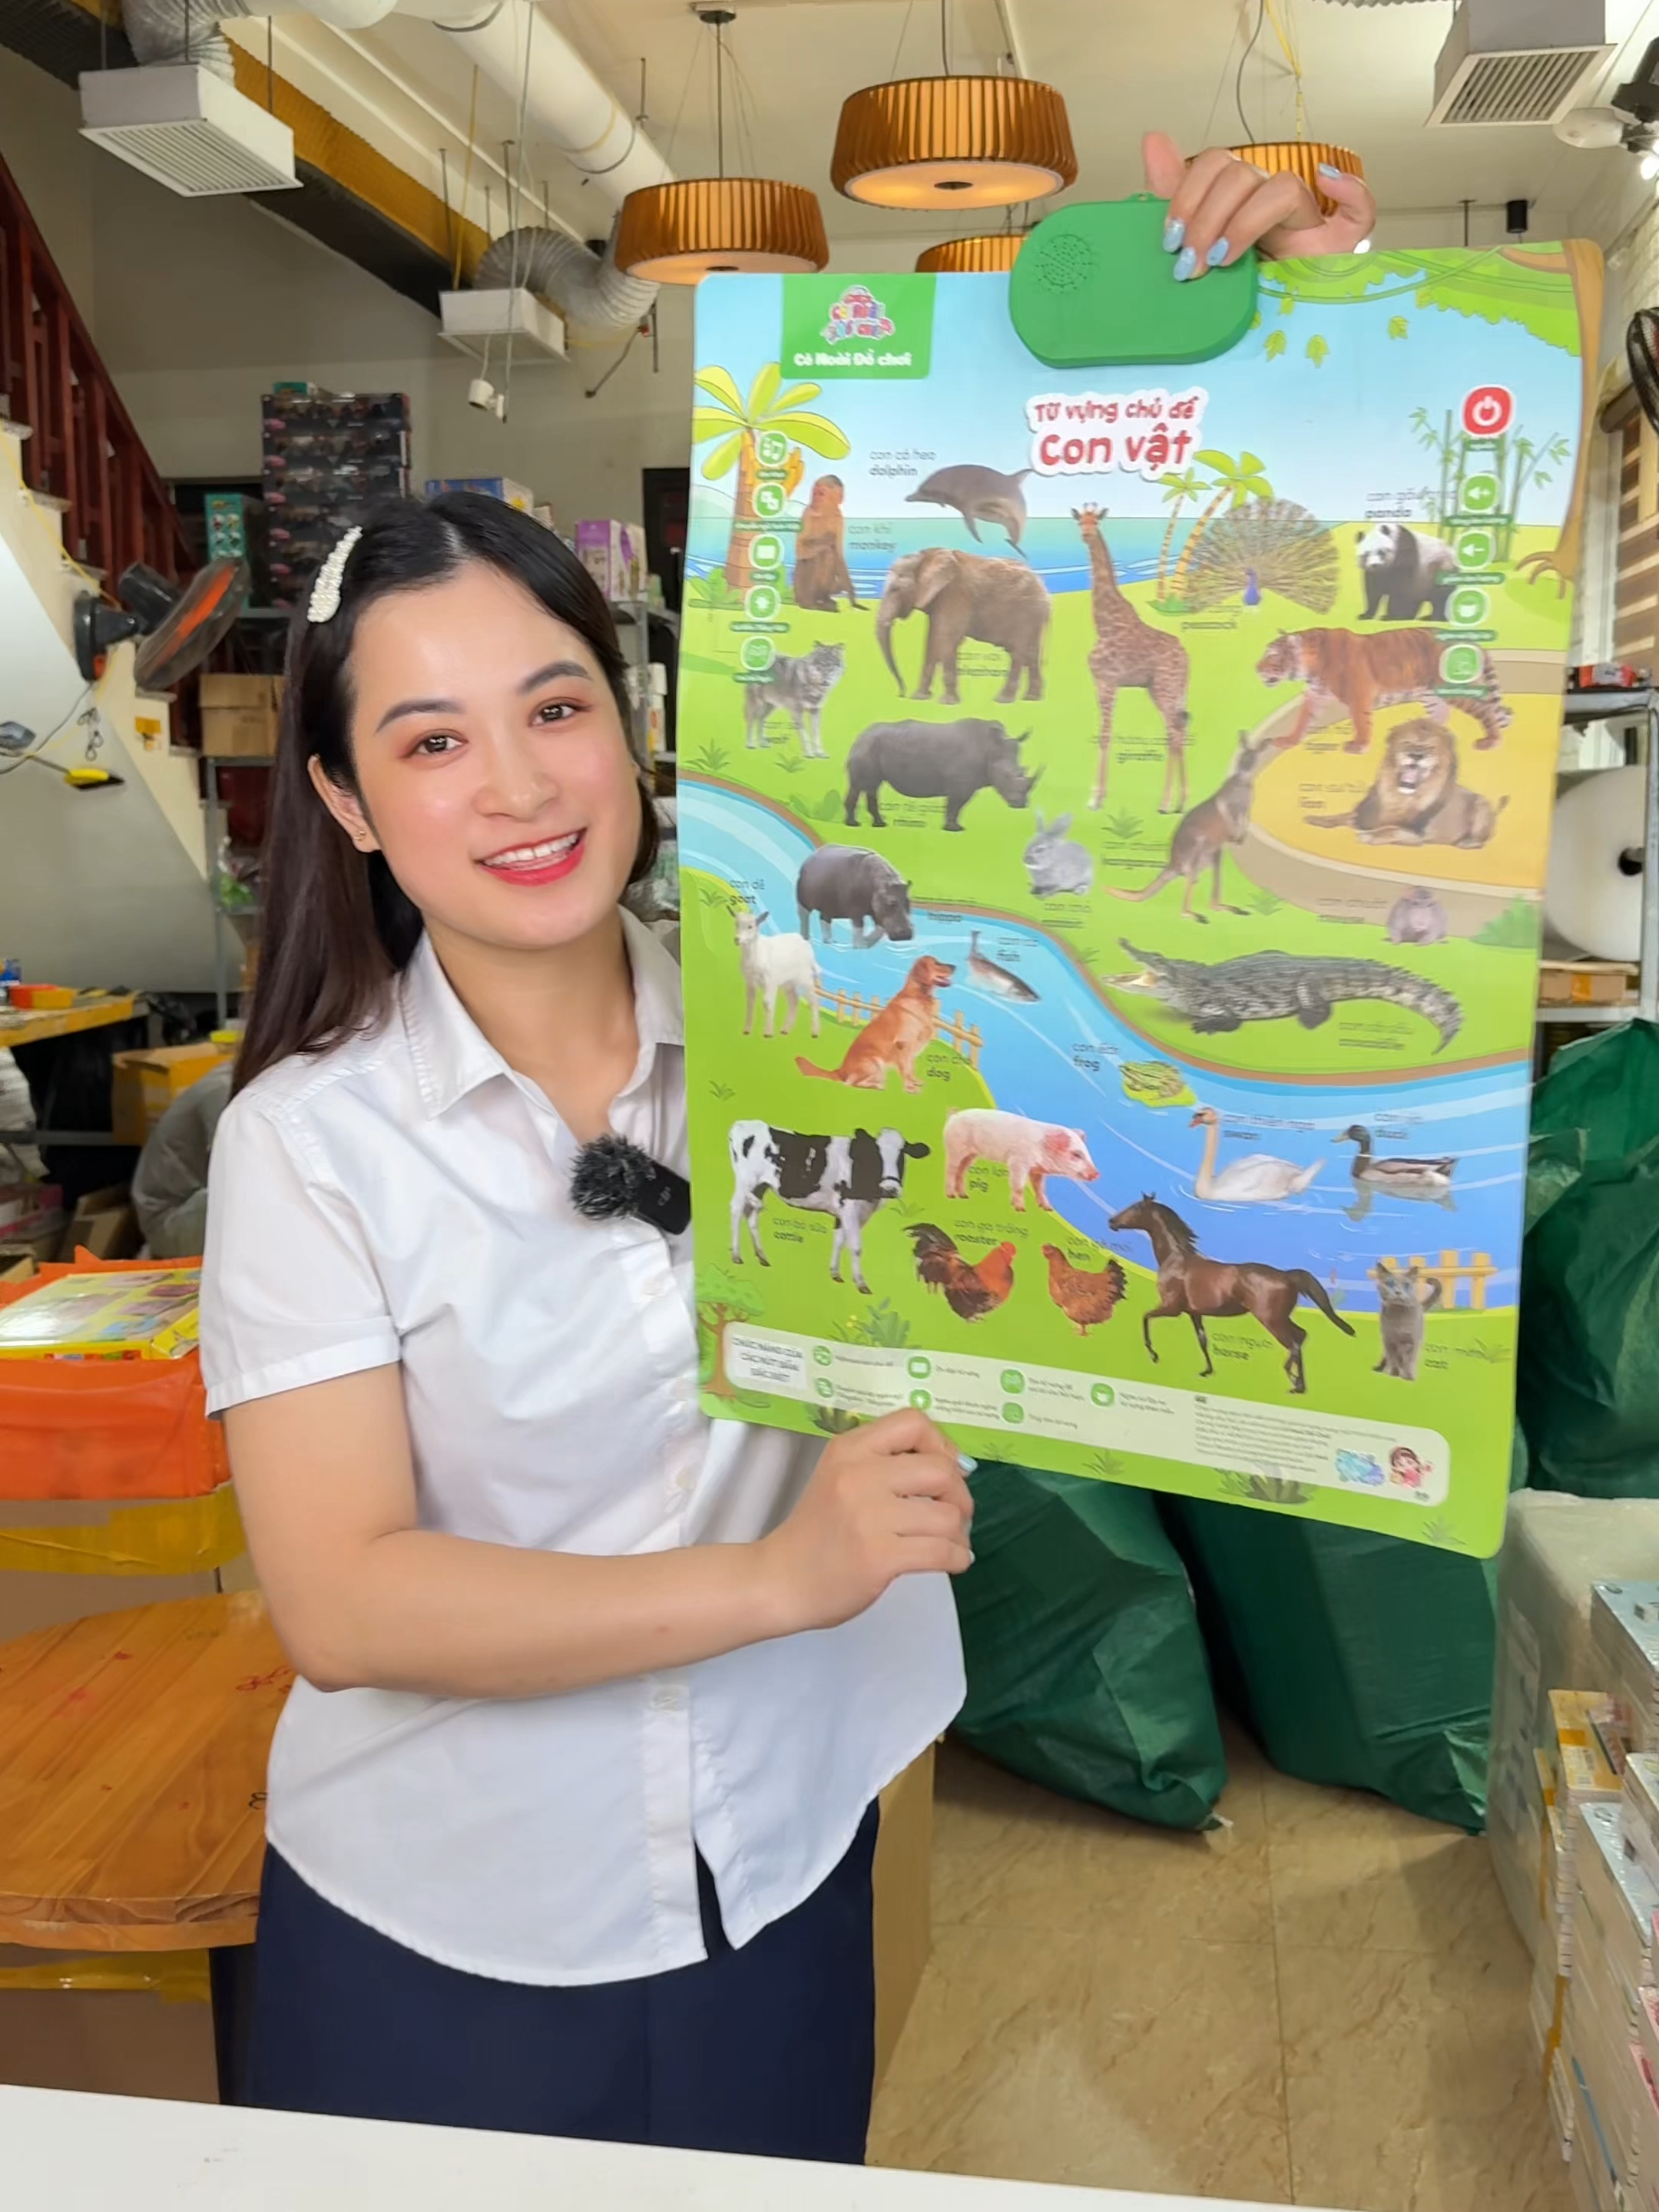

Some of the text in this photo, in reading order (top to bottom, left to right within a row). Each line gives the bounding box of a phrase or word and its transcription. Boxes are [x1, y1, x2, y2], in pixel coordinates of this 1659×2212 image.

[1065, 400, 1119, 423] vựng
[1125, 397, 1162, 419] chủ
[1169, 396, 1200, 419] đề
[1040, 422, 1193, 471] Con vật
[869, 463, 919, 479] dolphin
